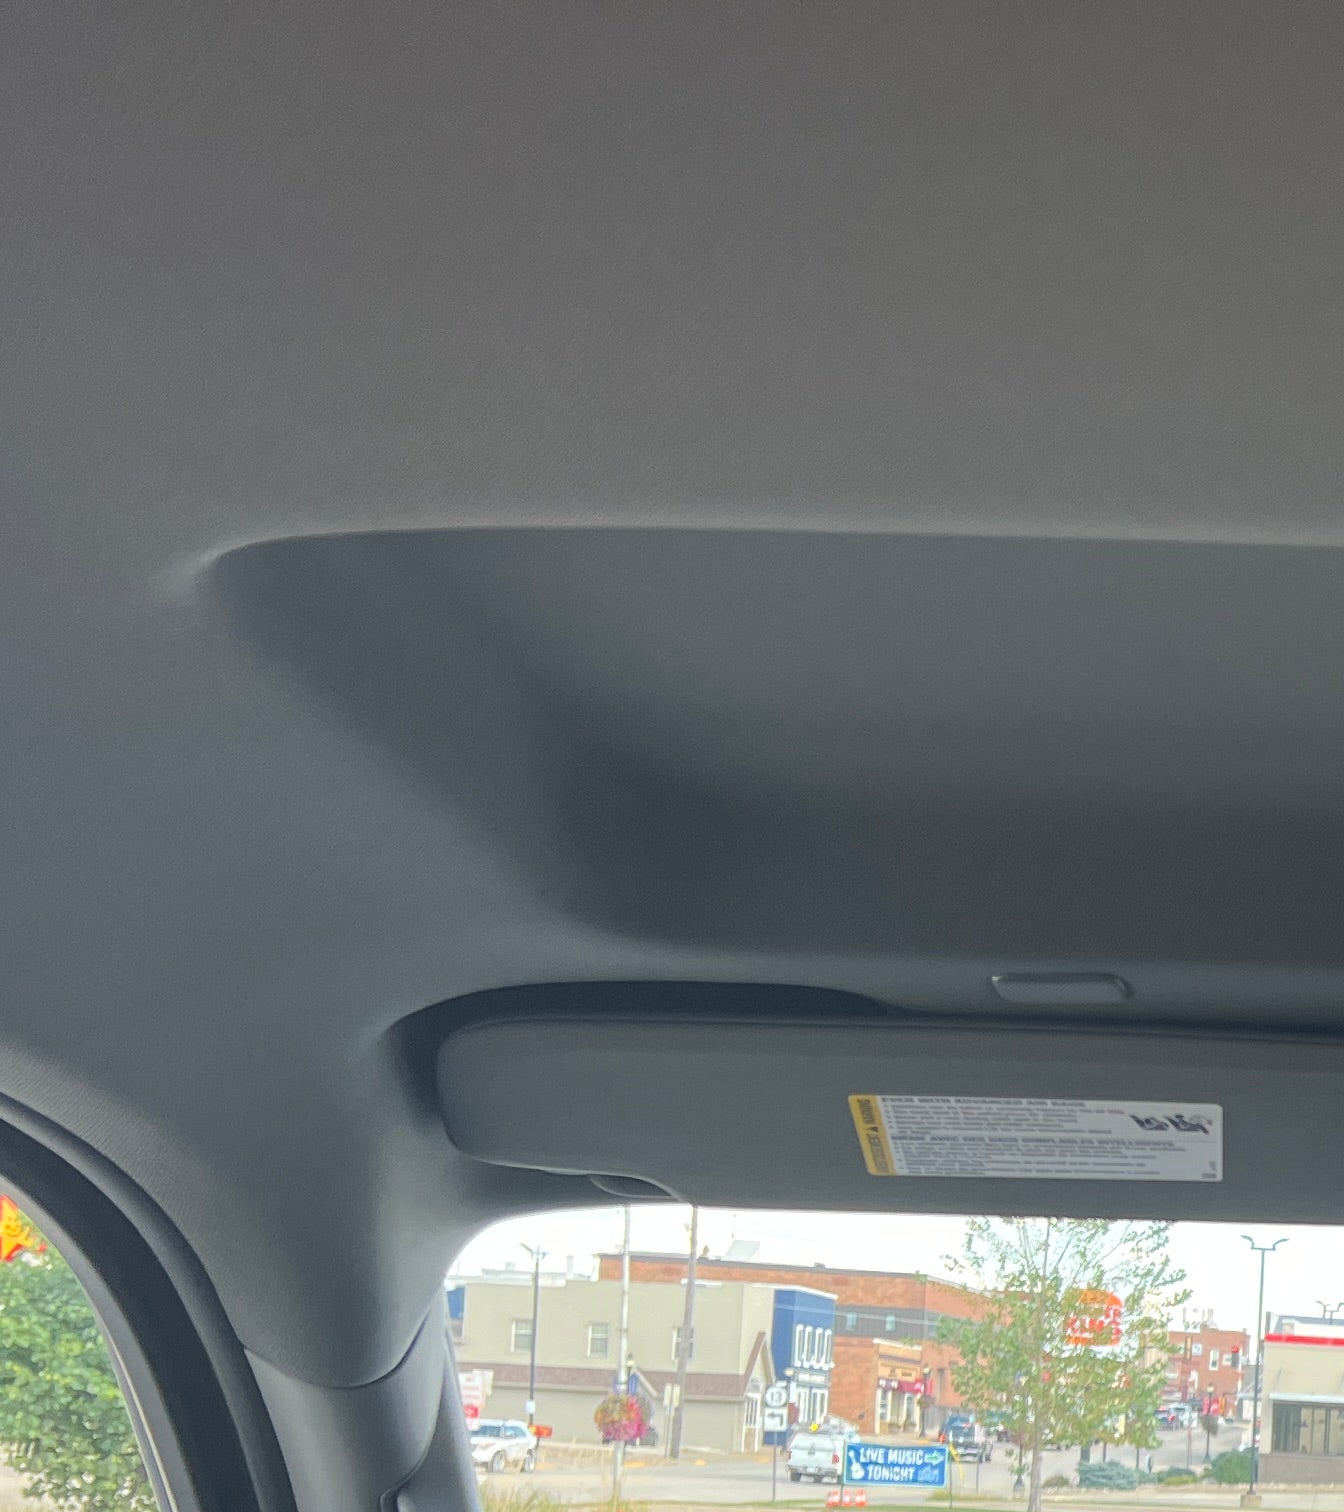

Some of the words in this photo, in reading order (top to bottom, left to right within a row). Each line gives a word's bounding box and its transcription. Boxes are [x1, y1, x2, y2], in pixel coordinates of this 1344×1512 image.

[859, 1447, 885, 1464] LIVE
[888, 1448, 924, 1466] MUSIC
[867, 1465, 916, 1482] TONIGHT
